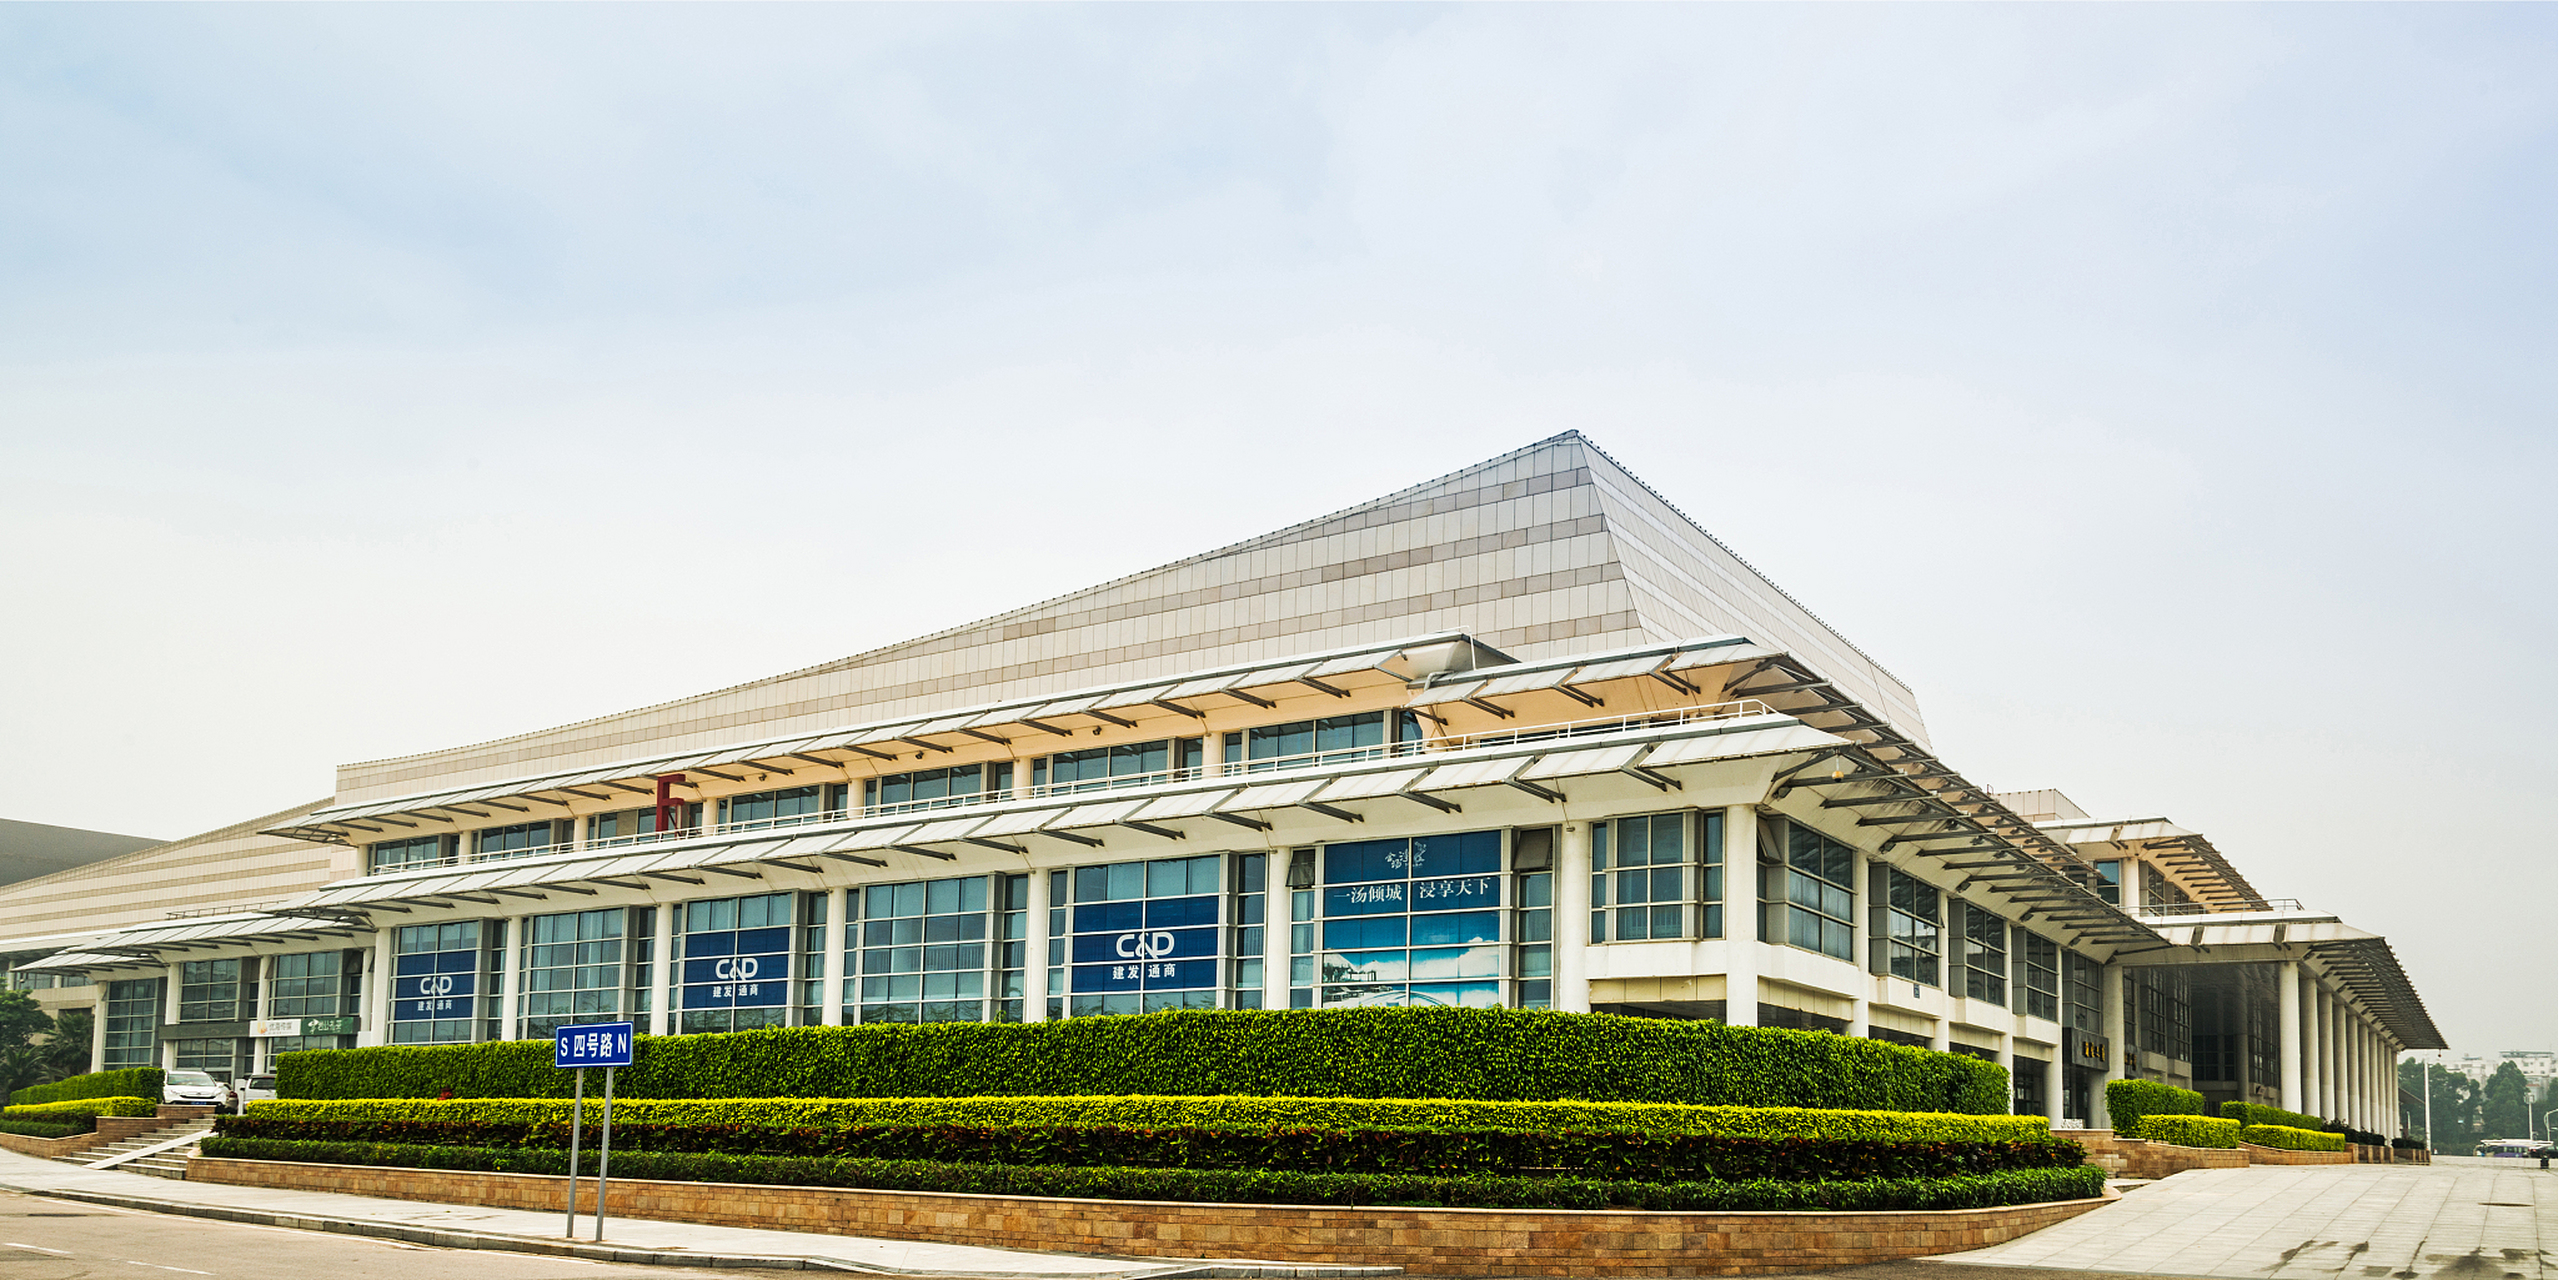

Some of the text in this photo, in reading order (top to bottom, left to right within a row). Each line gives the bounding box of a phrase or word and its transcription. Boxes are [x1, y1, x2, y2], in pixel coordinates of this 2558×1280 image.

[656, 773, 686, 841] F
[1333, 877, 1491, 903] 一汤倾城 浸享天下
[1116, 931, 1175, 960] C&D
[715, 957, 759, 981] C&D
[1112, 963, 1176, 980] 建发通商
[420, 976, 453, 996] C&D
[712, 984, 759, 998] 建发通商
[560, 1032, 627, 1058] S 四号路 N
